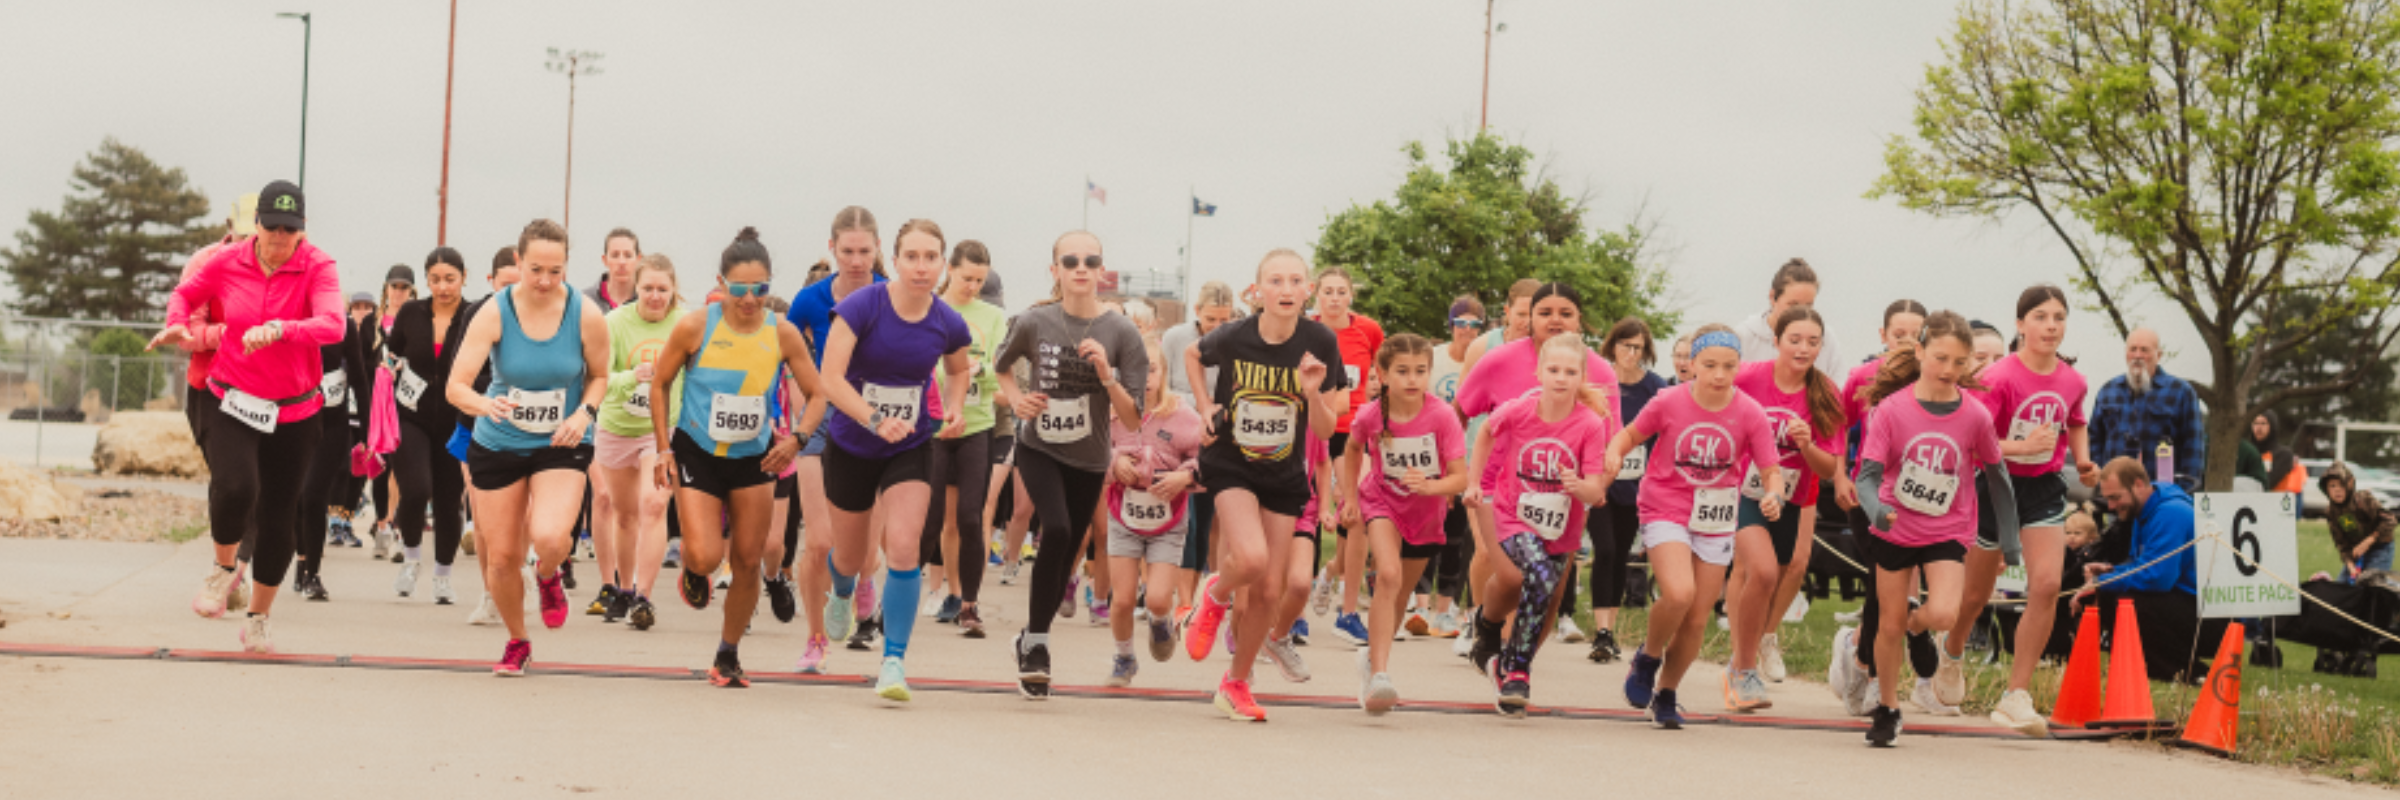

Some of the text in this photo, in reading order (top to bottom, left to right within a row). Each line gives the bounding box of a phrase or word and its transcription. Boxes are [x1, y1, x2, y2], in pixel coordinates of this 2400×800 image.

[1232, 359, 1301, 394] NIRVAN
[715, 411, 760, 430] 5693
[1041, 413, 1085, 431] 5444
[1241, 417, 1288, 435] 5435
[1690, 433, 1721, 467] 5K
[1917, 444, 1948, 474] 5K
[1532, 449, 1562, 481] 5K
[1902, 477, 1948, 506] 5644
[1523, 504, 1565, 530] 5512
[1697, 503, 1734, 522] 5418
[2232, 506, 2261, 577] 6
